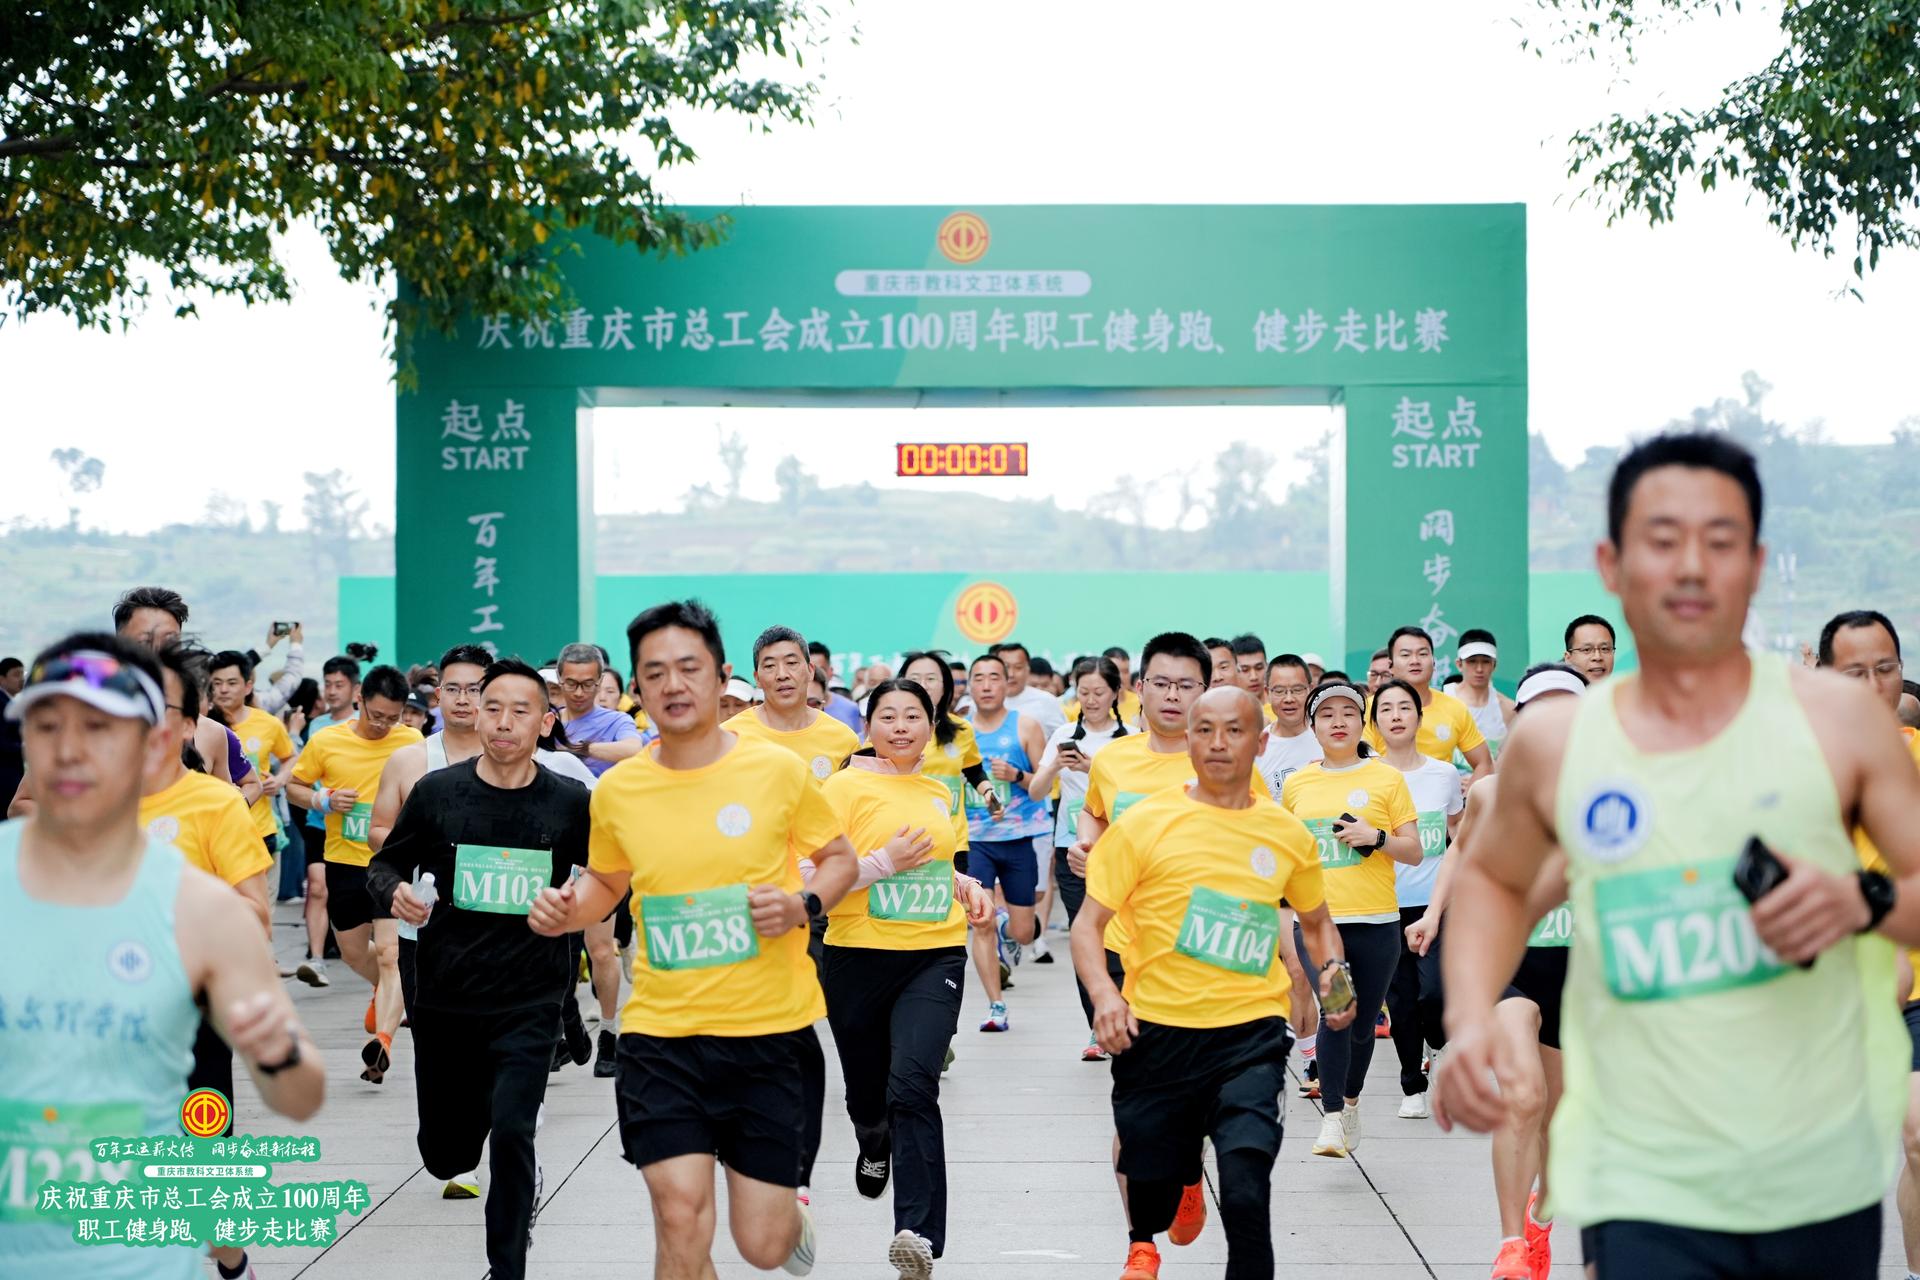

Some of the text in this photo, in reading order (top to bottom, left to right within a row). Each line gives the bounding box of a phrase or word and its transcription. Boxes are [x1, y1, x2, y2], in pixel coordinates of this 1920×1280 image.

[864, 274, 1064, 293] 重庆市教科文卫体系统
[441, 398, 531, 442] 起点
[1391, 395, 1483, 440] 起点
[441, 446, 530, 470] START
[901, 444, 1026, 475] 00:00:07
[1392, 443, 1481, 468] START
[467, 512, 505, 663] 百年工
[460, 870, 544, 906] M103
[874, 882, 948, 913] W222
[647, 914, 751, 962] M238
[1182, 913, 1272, 967] M104
[1611, 905, 1780, 993] M20
